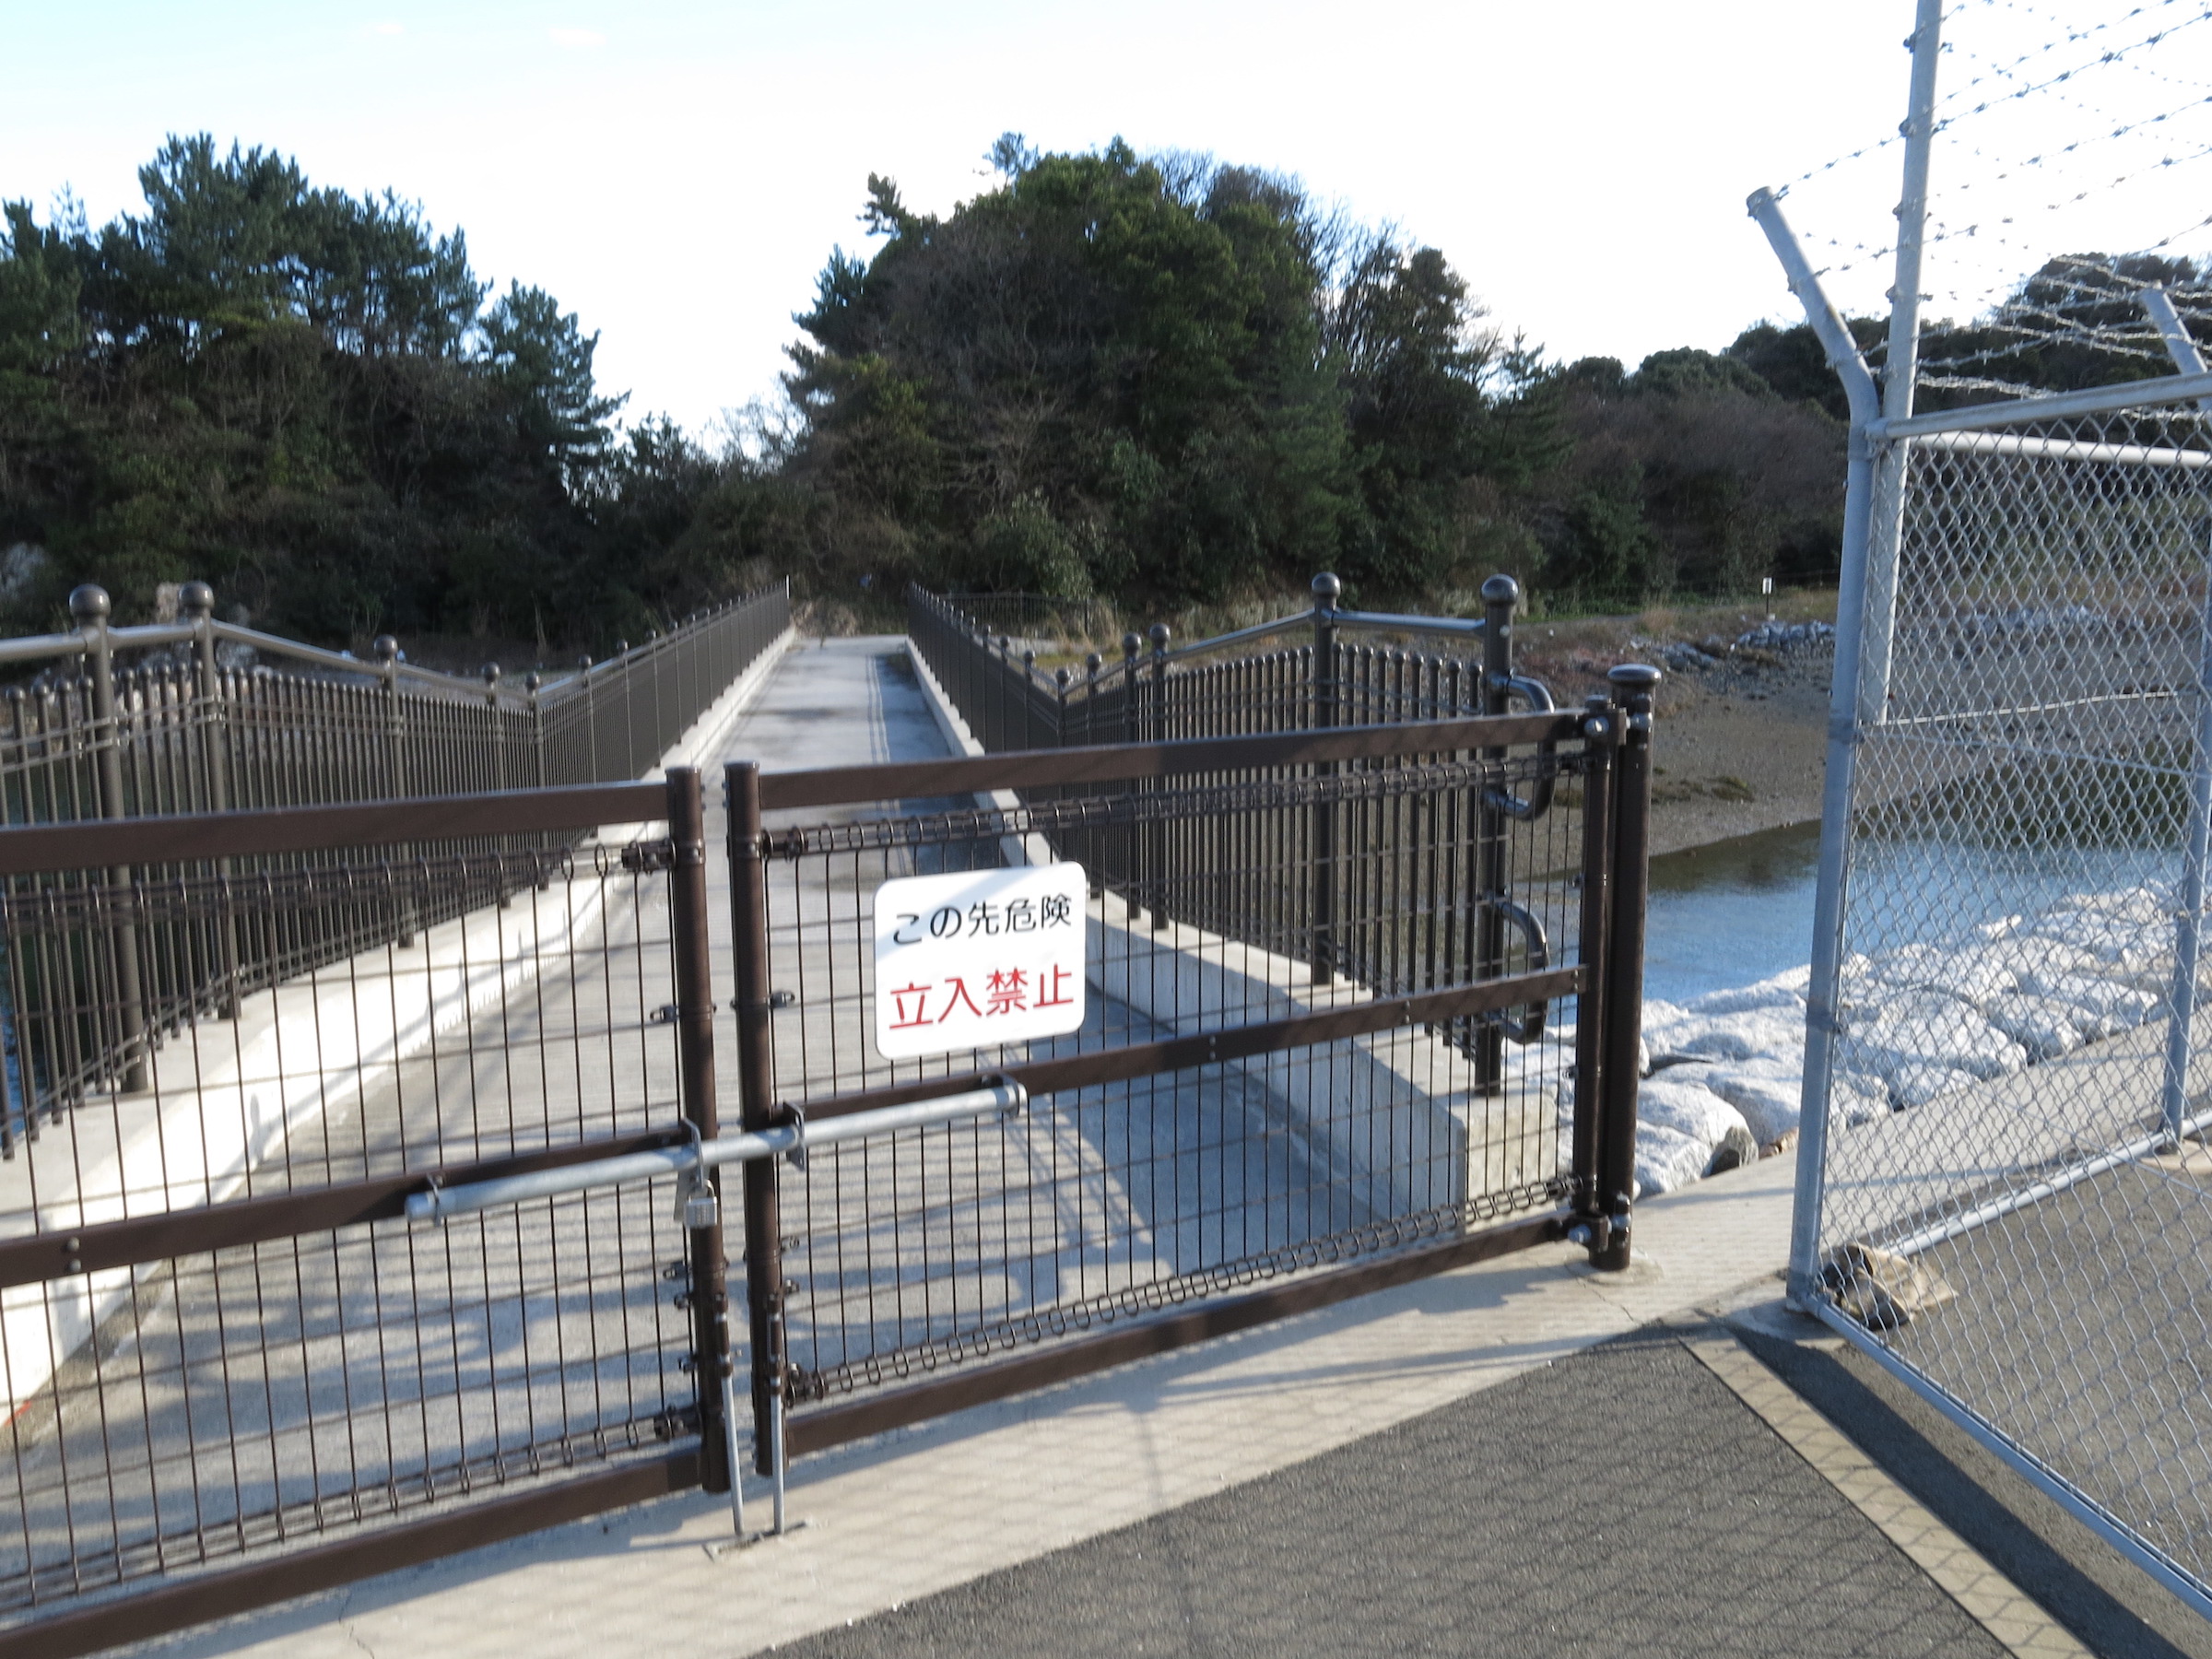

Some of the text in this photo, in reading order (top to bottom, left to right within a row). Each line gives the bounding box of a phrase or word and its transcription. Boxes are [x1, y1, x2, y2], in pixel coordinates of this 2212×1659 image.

[893, 893, 1072, 945] この先危険
[888, 963, 1074, 1030] 立入禁止
